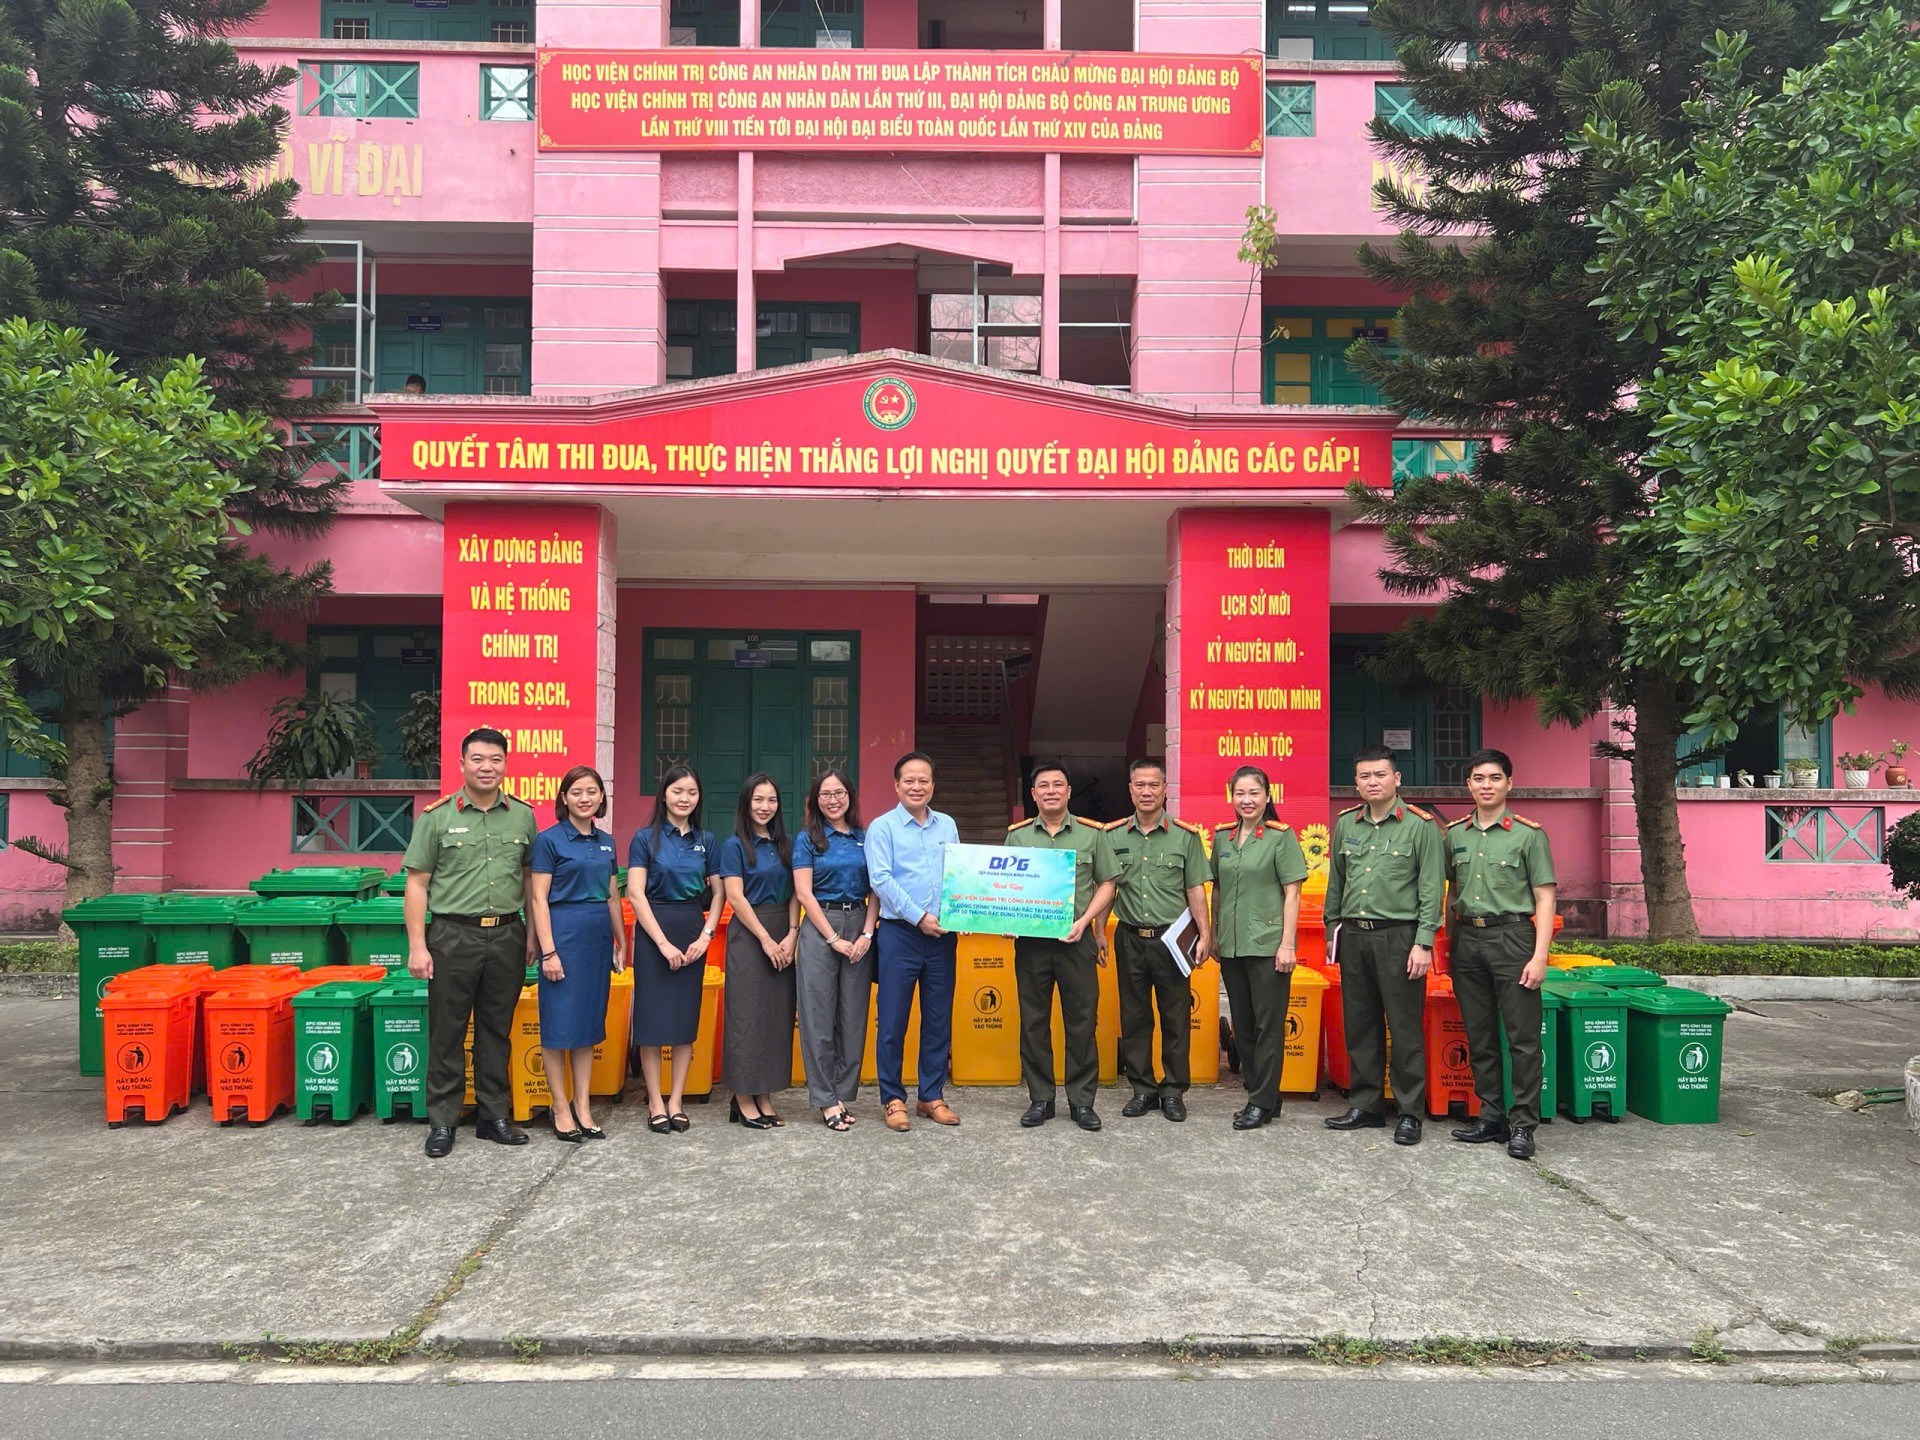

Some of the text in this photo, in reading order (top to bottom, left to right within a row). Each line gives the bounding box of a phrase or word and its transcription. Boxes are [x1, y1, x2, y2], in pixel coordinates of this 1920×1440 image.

[562, 61, 1240, 90] HỌC VIỆN CHÍNH TRỊ CÔNG AN NHÂN DÂN THI ĐUA LẬP THÀNH TÍCH CHÀO MỪNG ĐẠI HỘI ĐẢNG BỘ
[571, 86, 1231, 114] HỌC VIỆN CHÍNH TRỊ CÔNG AN NHÂN DÂN LẦN THỨ III, ĐẠI HỘI ĐẢNG BỘ CÔNG AN TRUNG ƯƠNG
[641, 113, 1163, 140] LẦN THỨ VIII TIẾN TỚI ĐẠI HỘI ĐẠI BIỂU TOÀN QUỐC LẦN THỨ XIV CỦA ĐẢNG
[308, 134, 348, 195] VĨ
[356, 143, 424, 207] ĐẠI
[412, 433, 1360, 480] QUYẾT TÂM THI ĐUA, THỰC HIỆN THẮNG LỢI NGHỊ QUYẾT ĐẠI HỘI ĐẢNG CÁC CẤP!
[458, 532, 583, 568] XÂY DỰNG ĐẢNG
[1227, 540, 1285, 569] THỜI ĐIỂM
[470, 579, 570, 615] VÀ HỆ THỐNG
[1221, 588, 1291, 620] LỊCH SỬ MỚI
[482, 630, 558, 663] CHÍNH TRỊ
[1207, 635, 1224, 663] KỶ
[1225, 637, 1271, 663] NGUYÊN
[1274, 638, 1297, 663] MỚI
[468, 681, 570, 711] TRONG SẠCH,
[1190, 682, 1321, 710] KỶ NGUYÊN VƯƠN MÌNH
[516, 729, 568, 758] MẠNH,
[1218, 730, 1293, 761] CỦA DÂN TỘC
